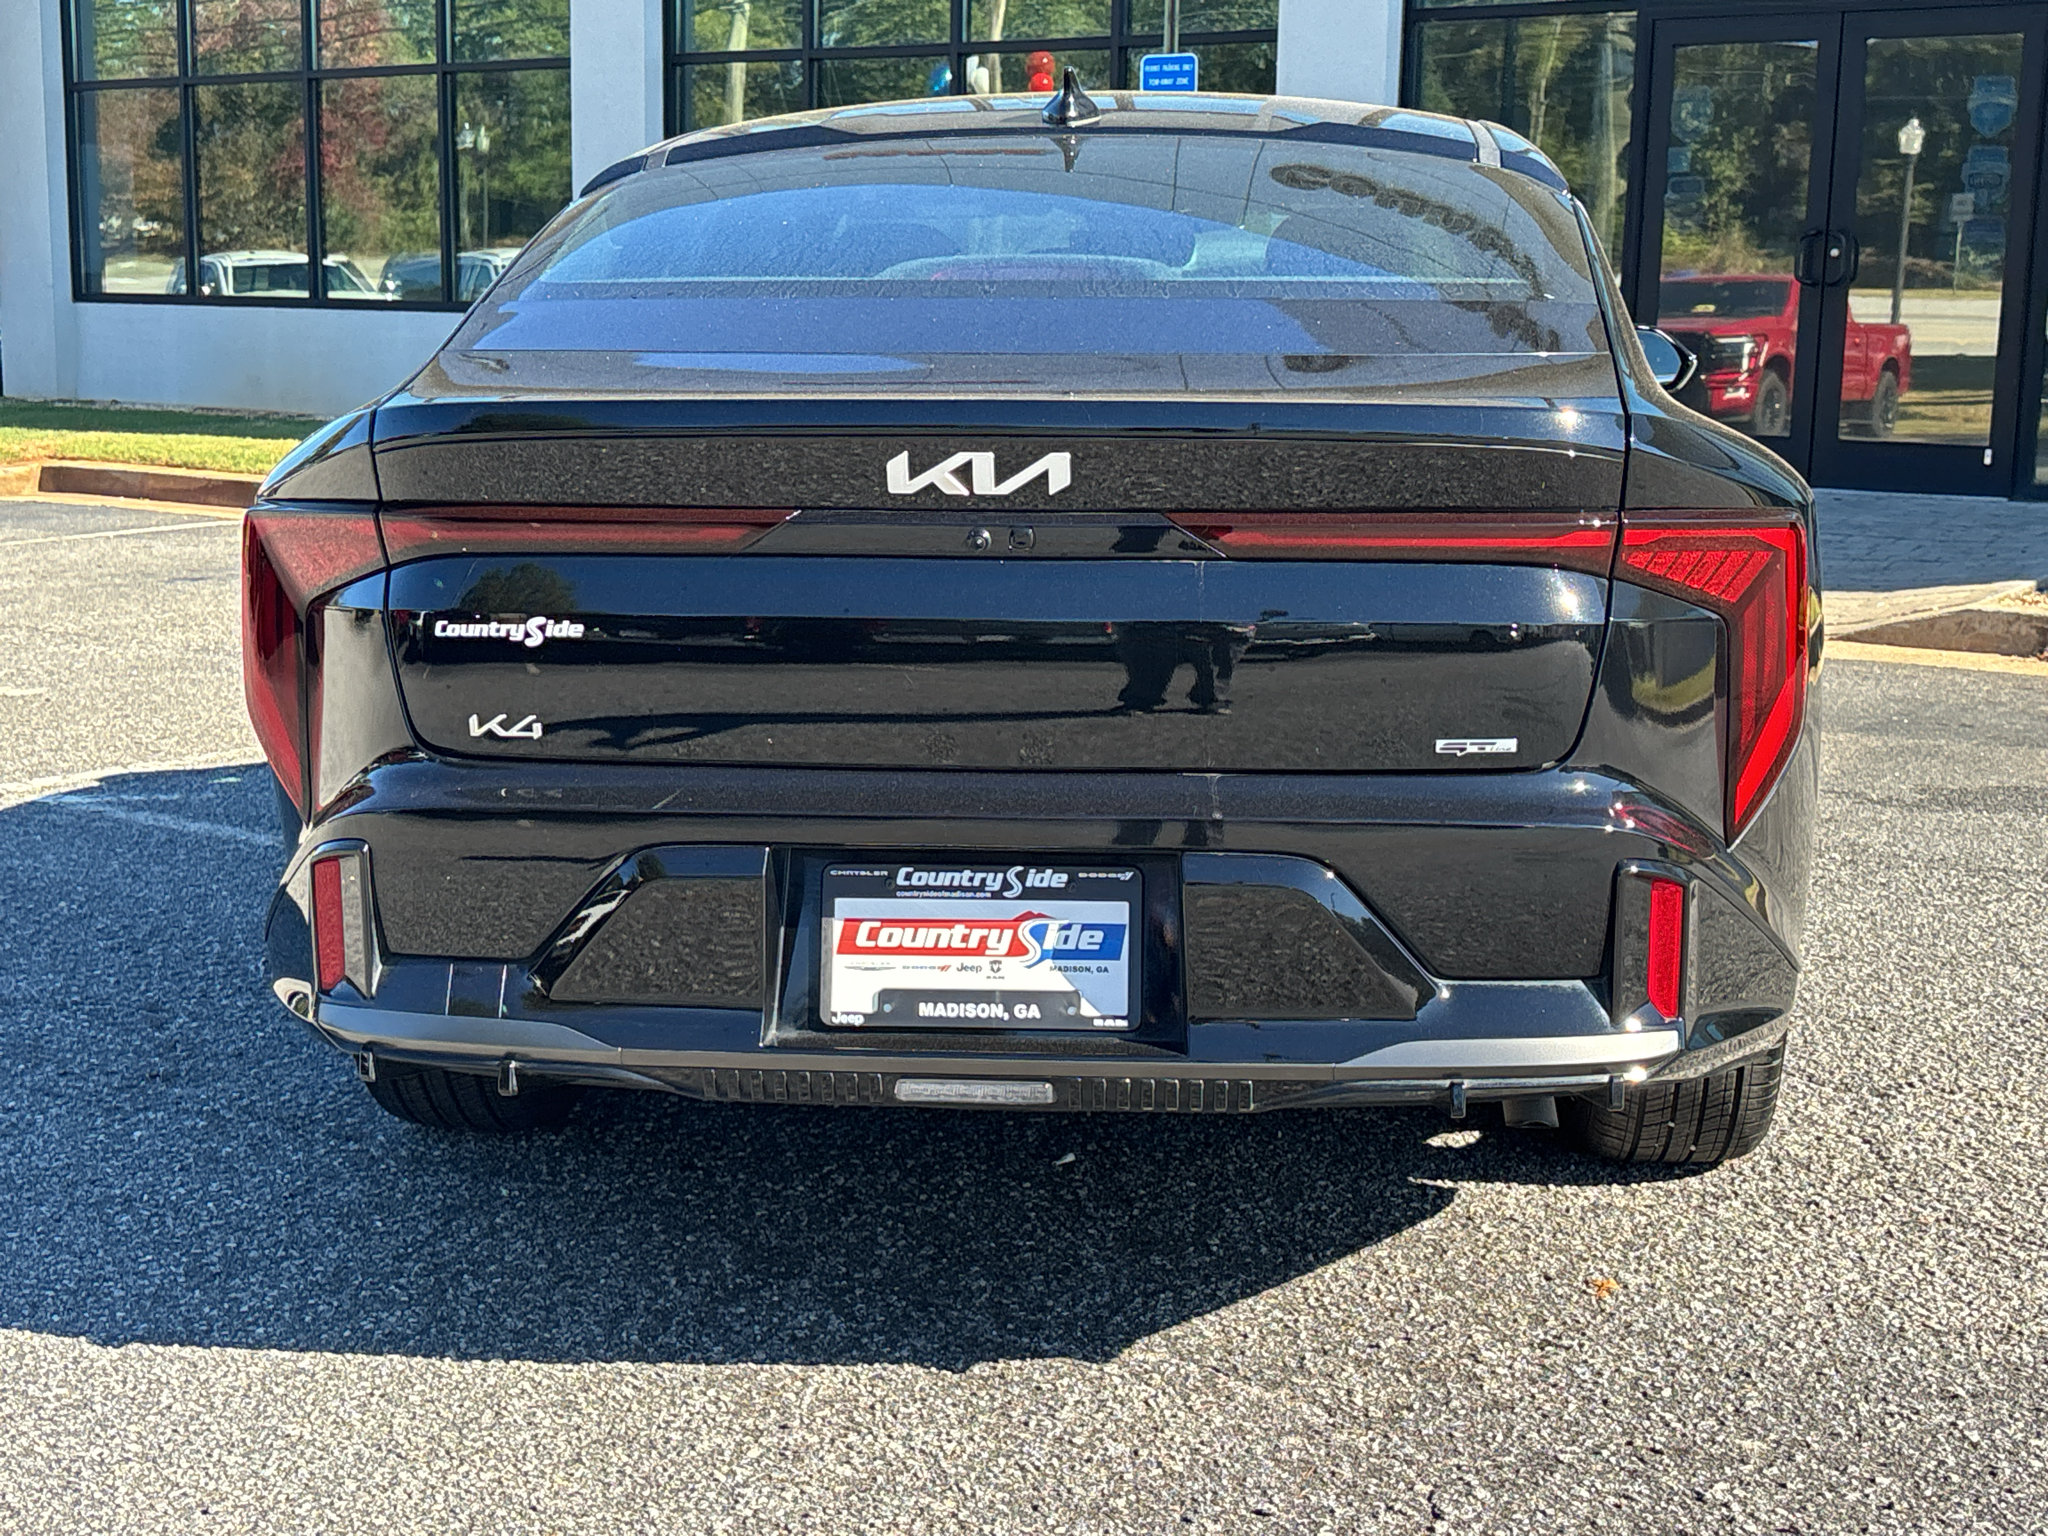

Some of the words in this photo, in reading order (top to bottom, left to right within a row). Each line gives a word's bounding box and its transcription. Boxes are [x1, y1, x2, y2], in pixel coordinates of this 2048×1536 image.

[886, 450, 1071, 496] KIA
[468, 714, 543, 740] K4
[956, 962, 983, 973] Jeep
[1096, 965, 1109, 973] GA
[918, 1002, 1010, 1020] MADISON,
[1013, 1003, 1041, 1019] GA
